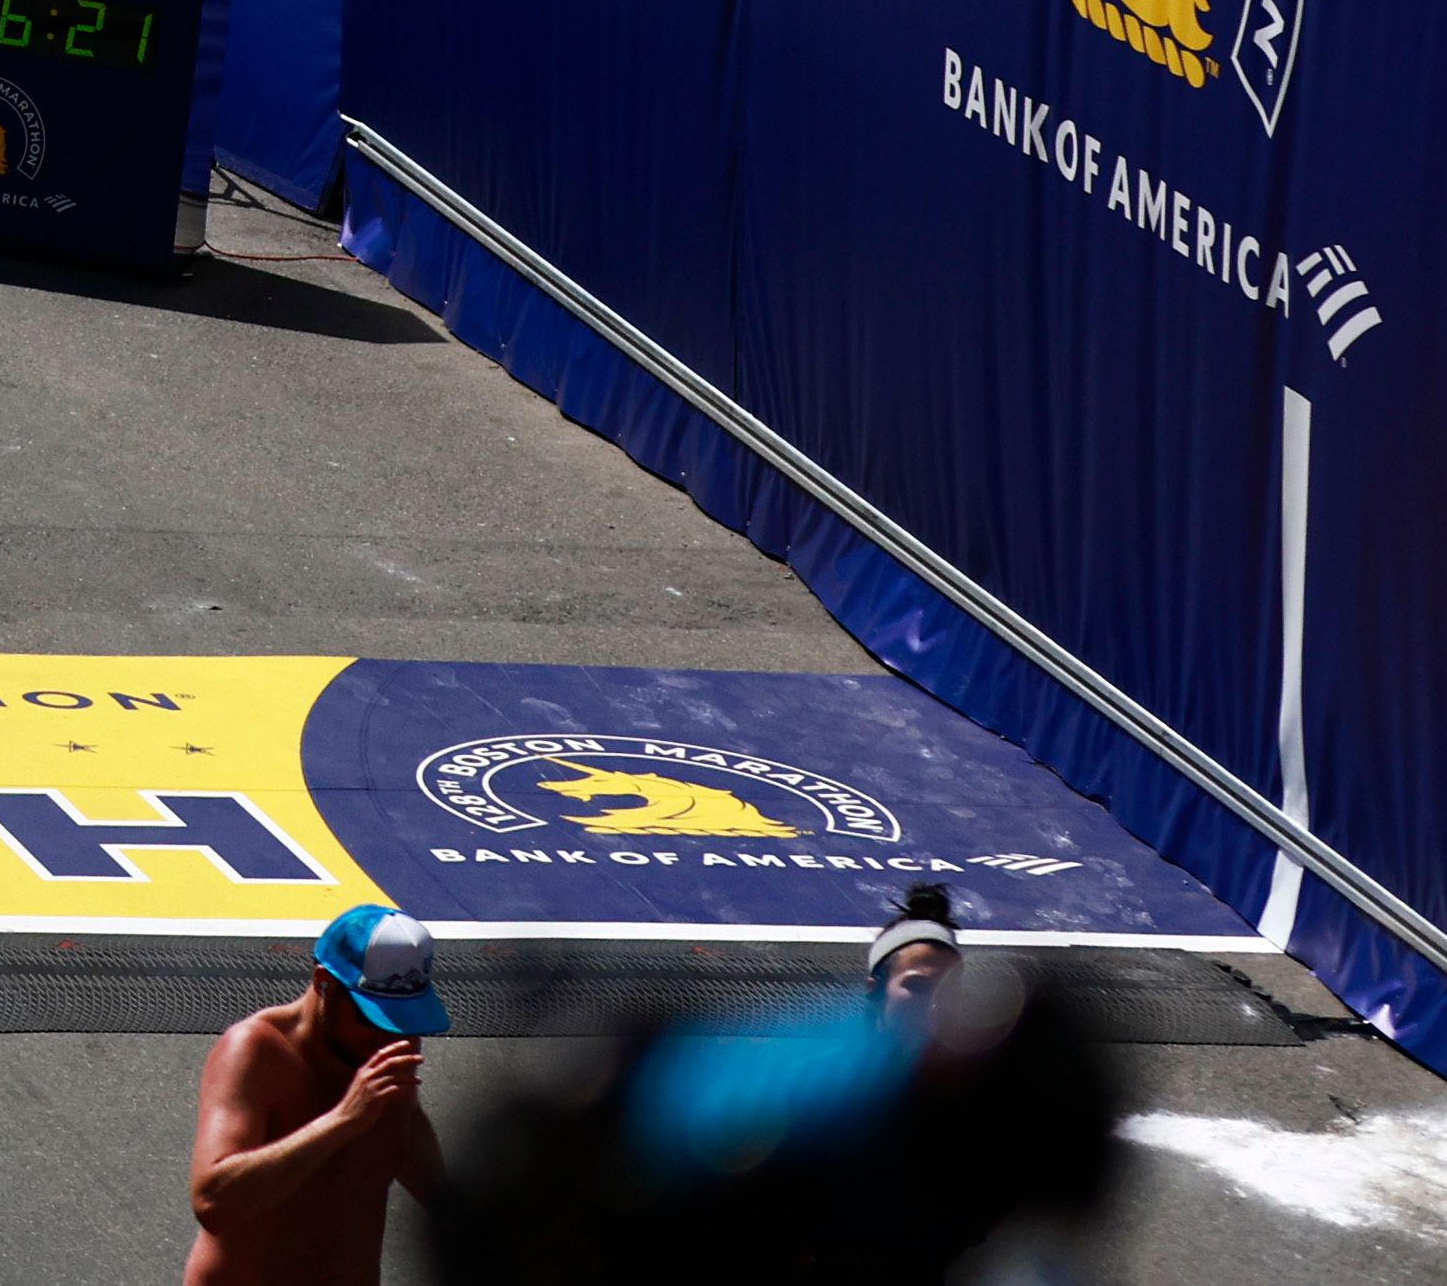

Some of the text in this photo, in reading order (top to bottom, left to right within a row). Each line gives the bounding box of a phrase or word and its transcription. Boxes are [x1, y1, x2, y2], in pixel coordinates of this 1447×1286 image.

[0, 81, 43, 168] MARATHON
[943, 46, 1292, 320] BANK OF AMERICA
[437, 737, 885, 834] 128TH BOSTON MARATHON
[430, 847, 965, 873] BANK OF AMERICA
